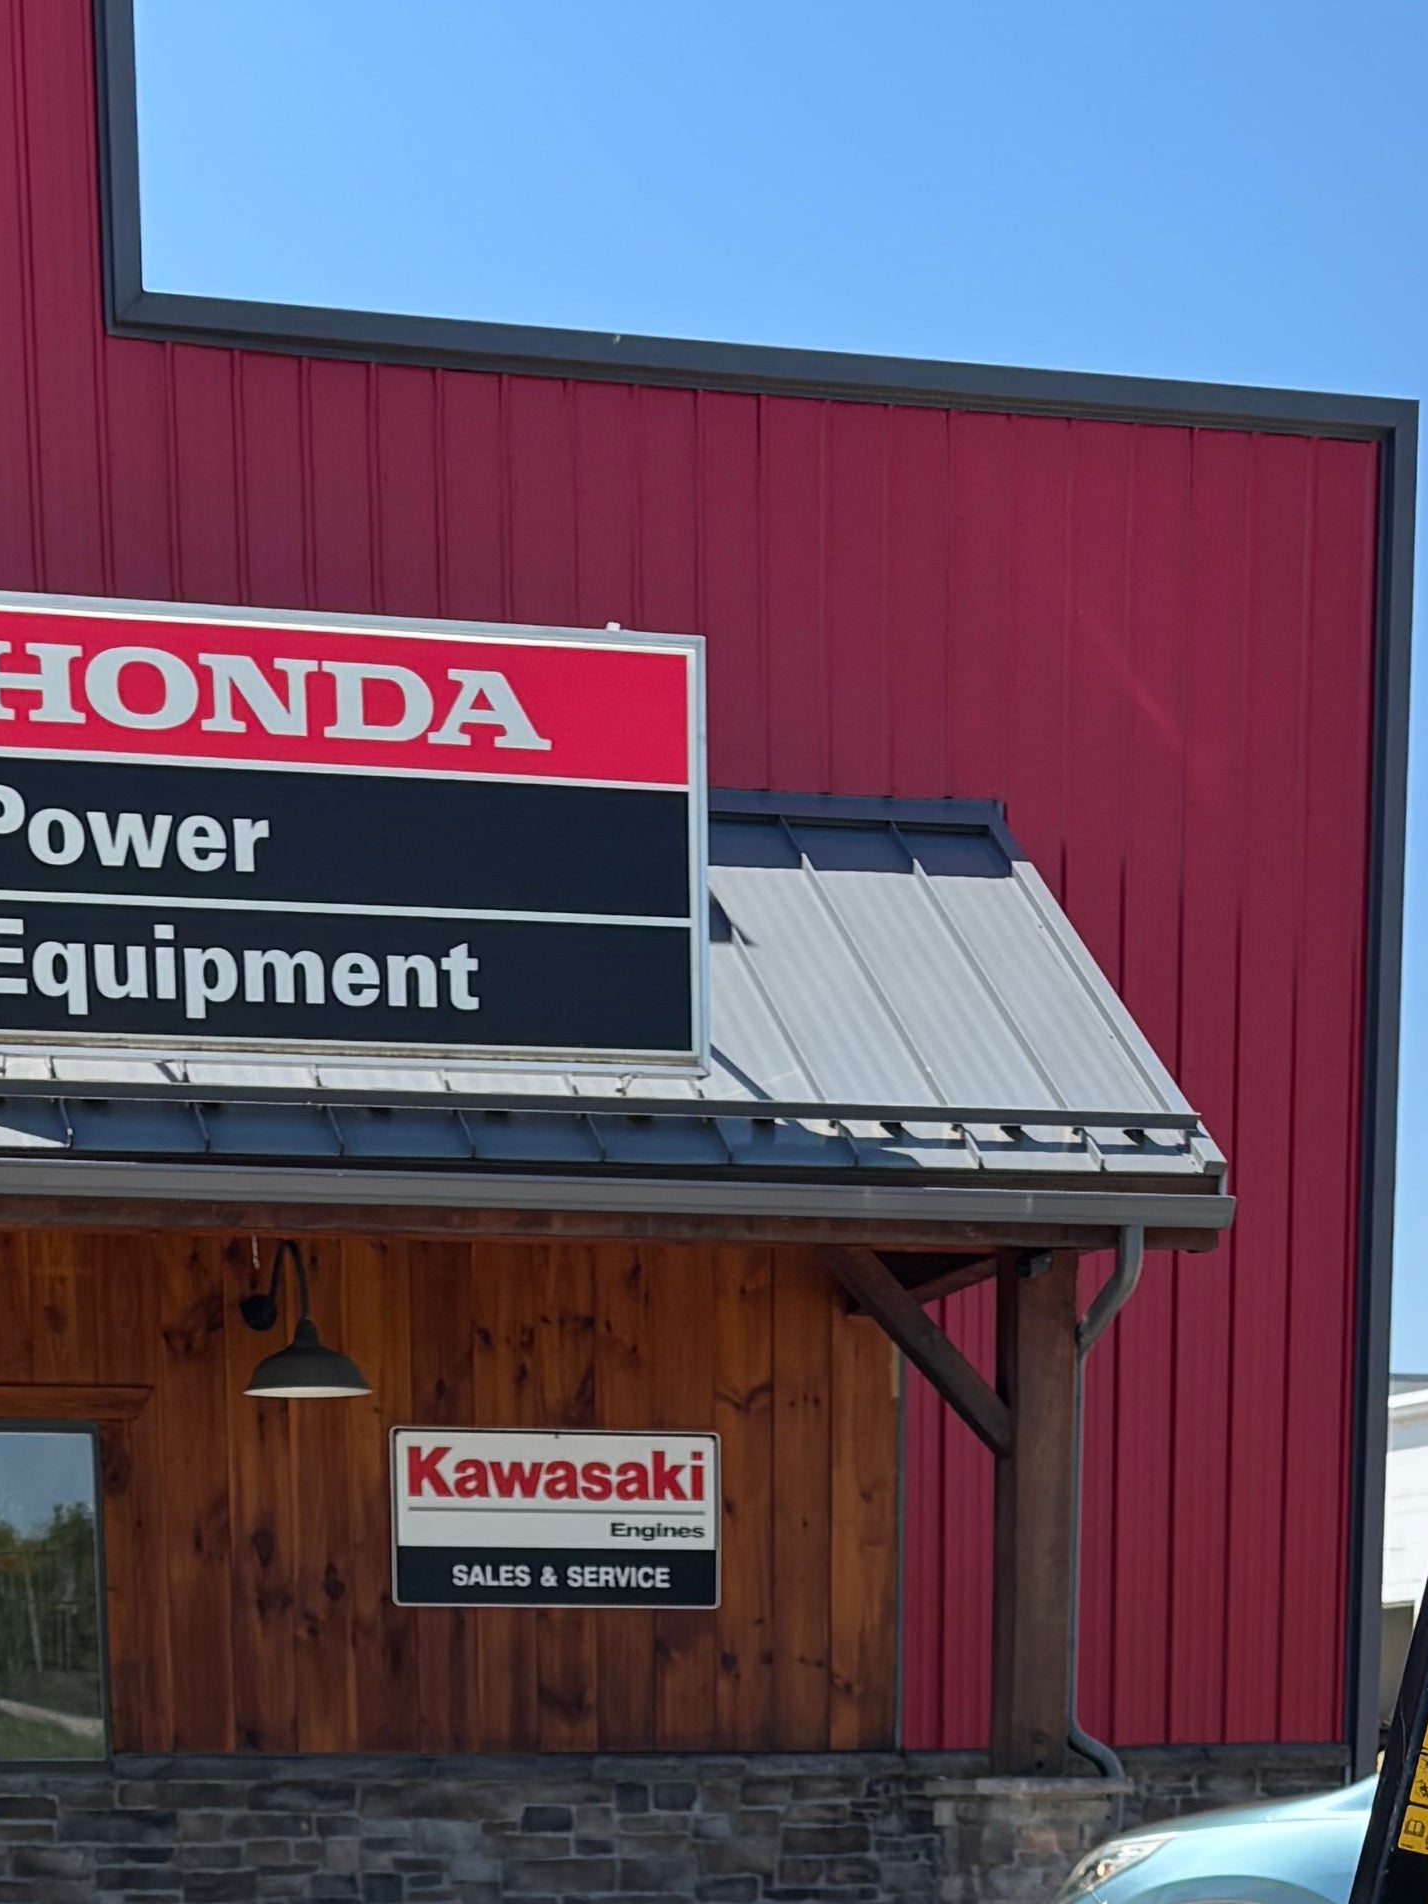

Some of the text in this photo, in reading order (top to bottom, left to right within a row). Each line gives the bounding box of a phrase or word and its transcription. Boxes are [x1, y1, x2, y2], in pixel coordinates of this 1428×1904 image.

[406, 1445, 705, 1502] Kawasaki
[610, 1521, 705, 1542] Engines
[452, 1564, 671, 1588] SALES & SERVICE
